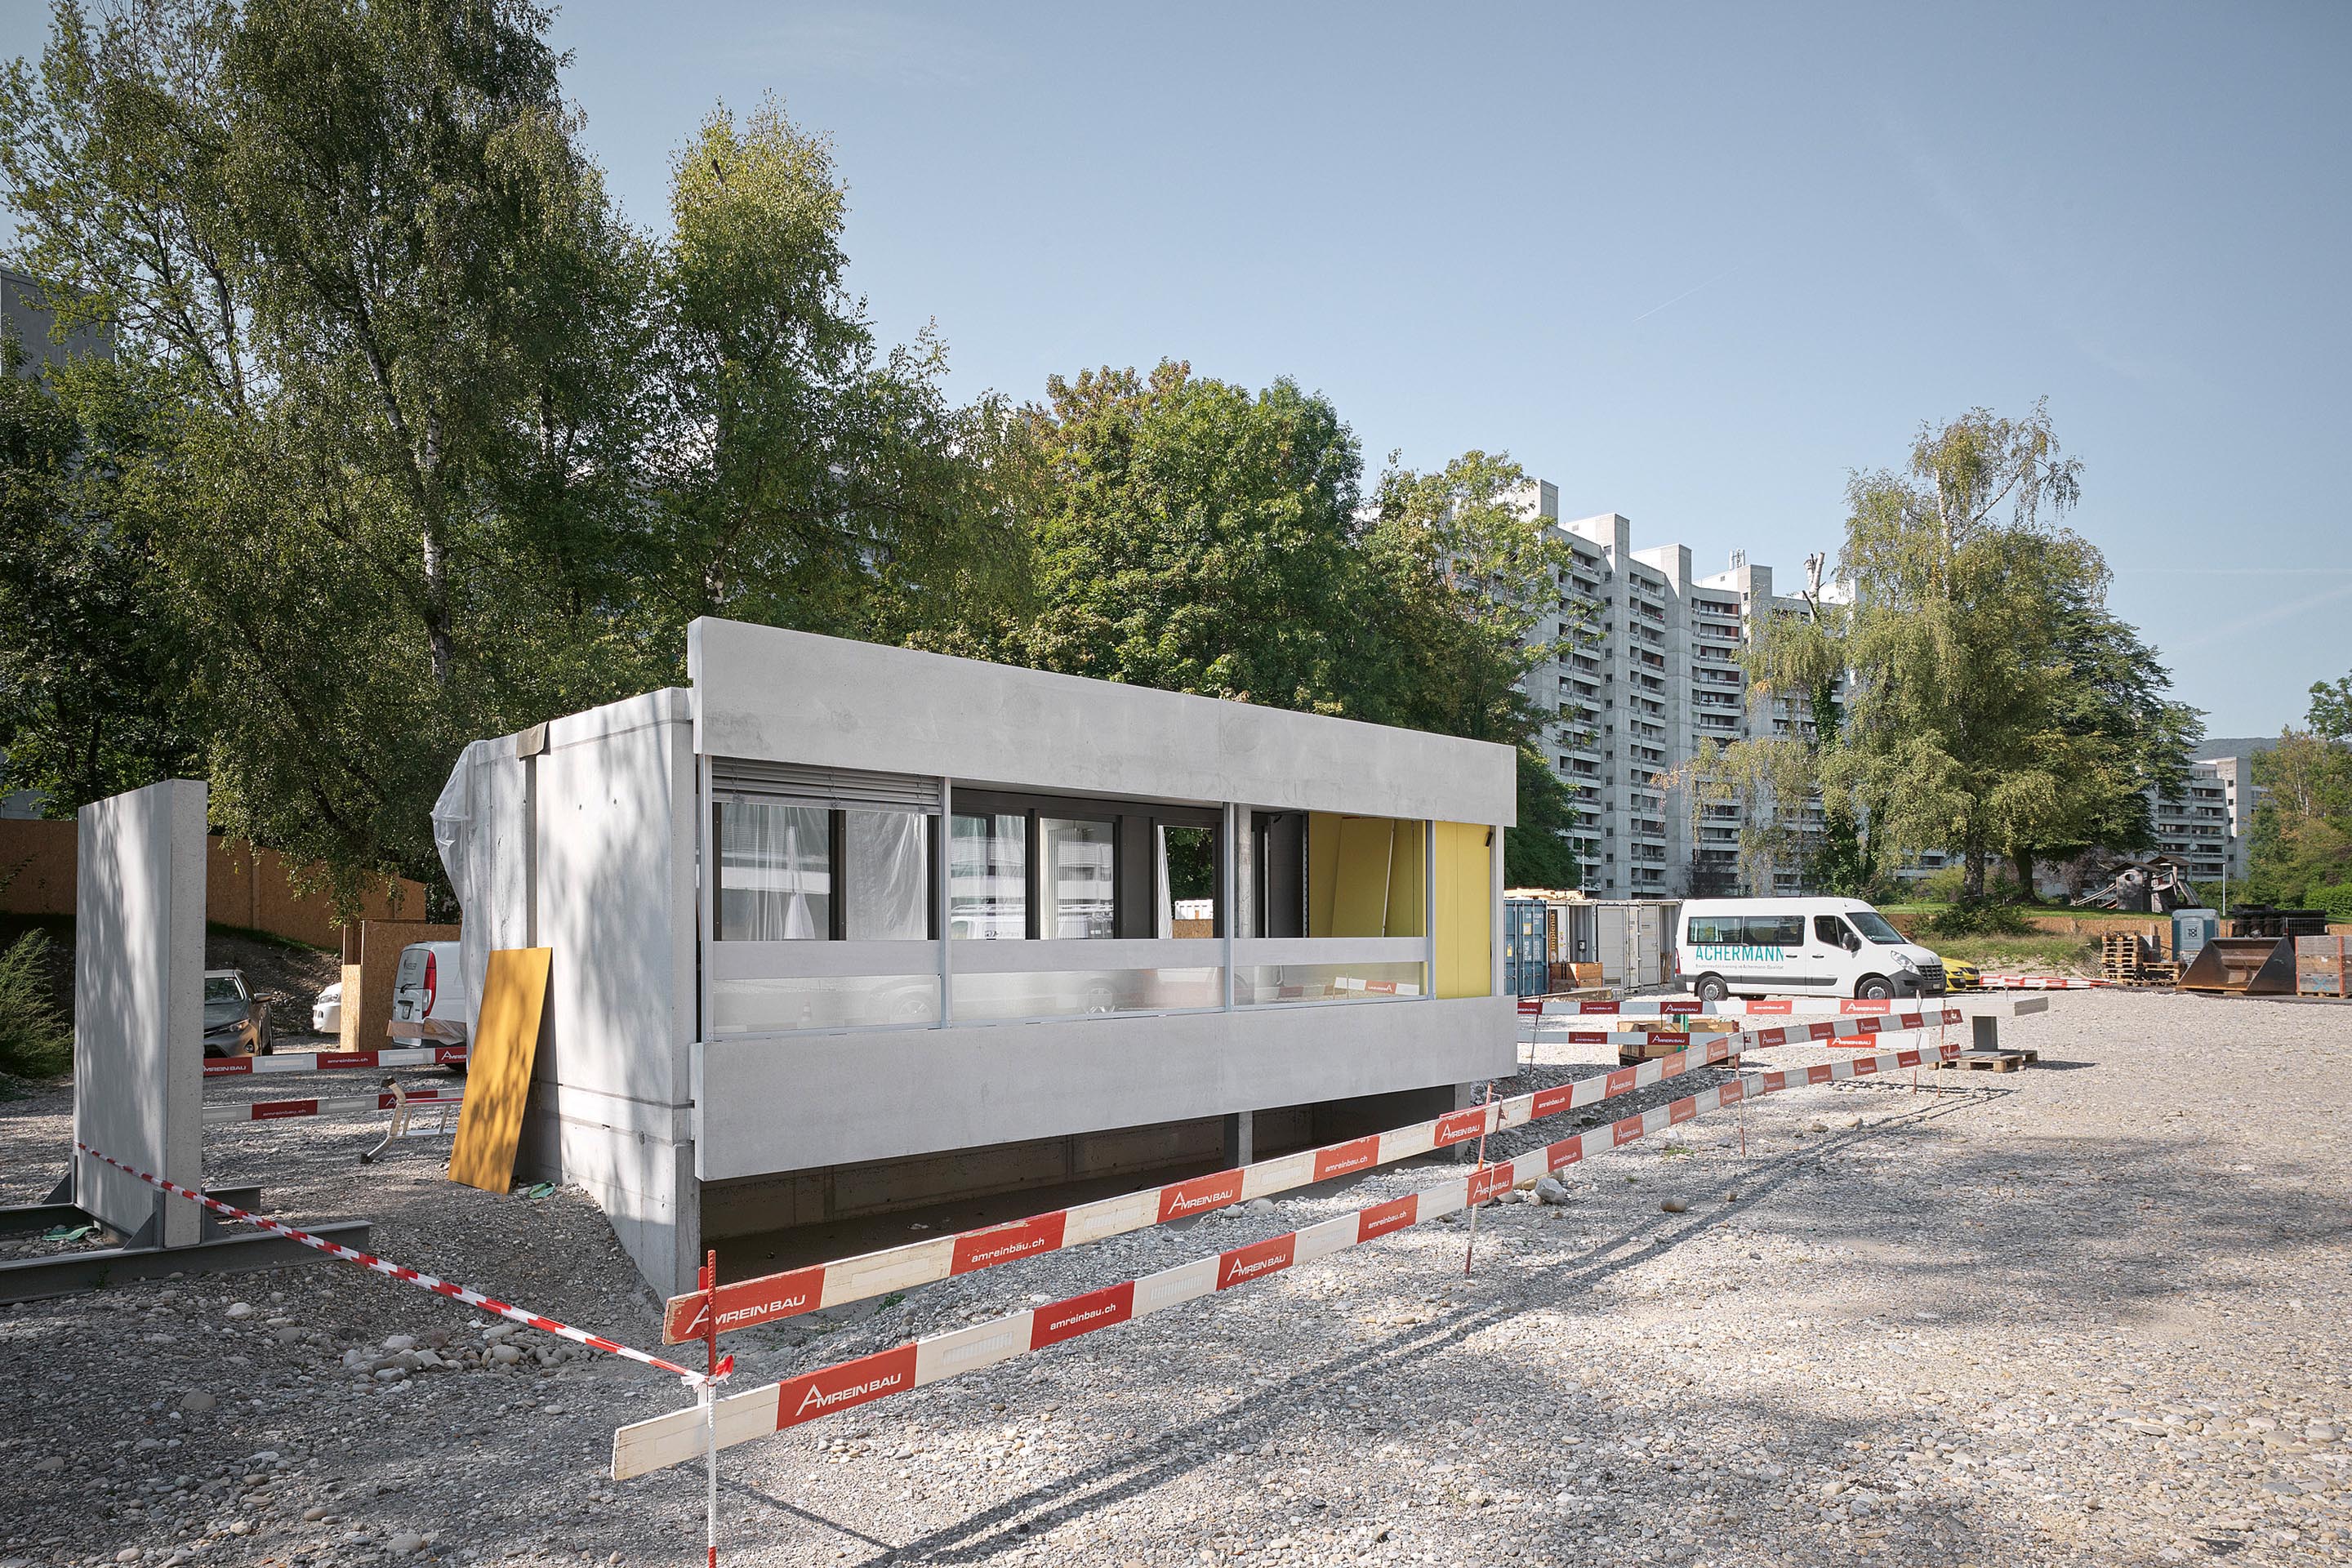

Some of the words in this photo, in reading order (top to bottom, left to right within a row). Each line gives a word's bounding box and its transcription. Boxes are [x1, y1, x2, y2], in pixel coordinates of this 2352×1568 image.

[1695, 946, 1784, 961] ACHERMANN
[1538, 1096, 1566, 1109] amreinbau.ch
[1440, 1123, 1468, 1143] AMREIN
[1467, 1124, 1480, 1134] BAU
[1325, 1155, 1368, 1173] amreinbau.ch
[1167, 1191, 1213, 1215] AMREIN
[1213, 1189, 1233, 1201] BAU
[1368, 1209, 1407, 1229] amreinbau.ch
[971, 1236, 1045, 1263] amreinbau.ch
[1227, 1258, 1267, 1281] AMREIN
[1267, 1254, 1286, 1267] BAU
[769, 1294, 806, 1312] BAU
[1049, 1303, 1116, 1331] amreinbau.ch
[795, 1384, 868, 1417] AMREIN
[869, 1373, 902, 1392] BAU
